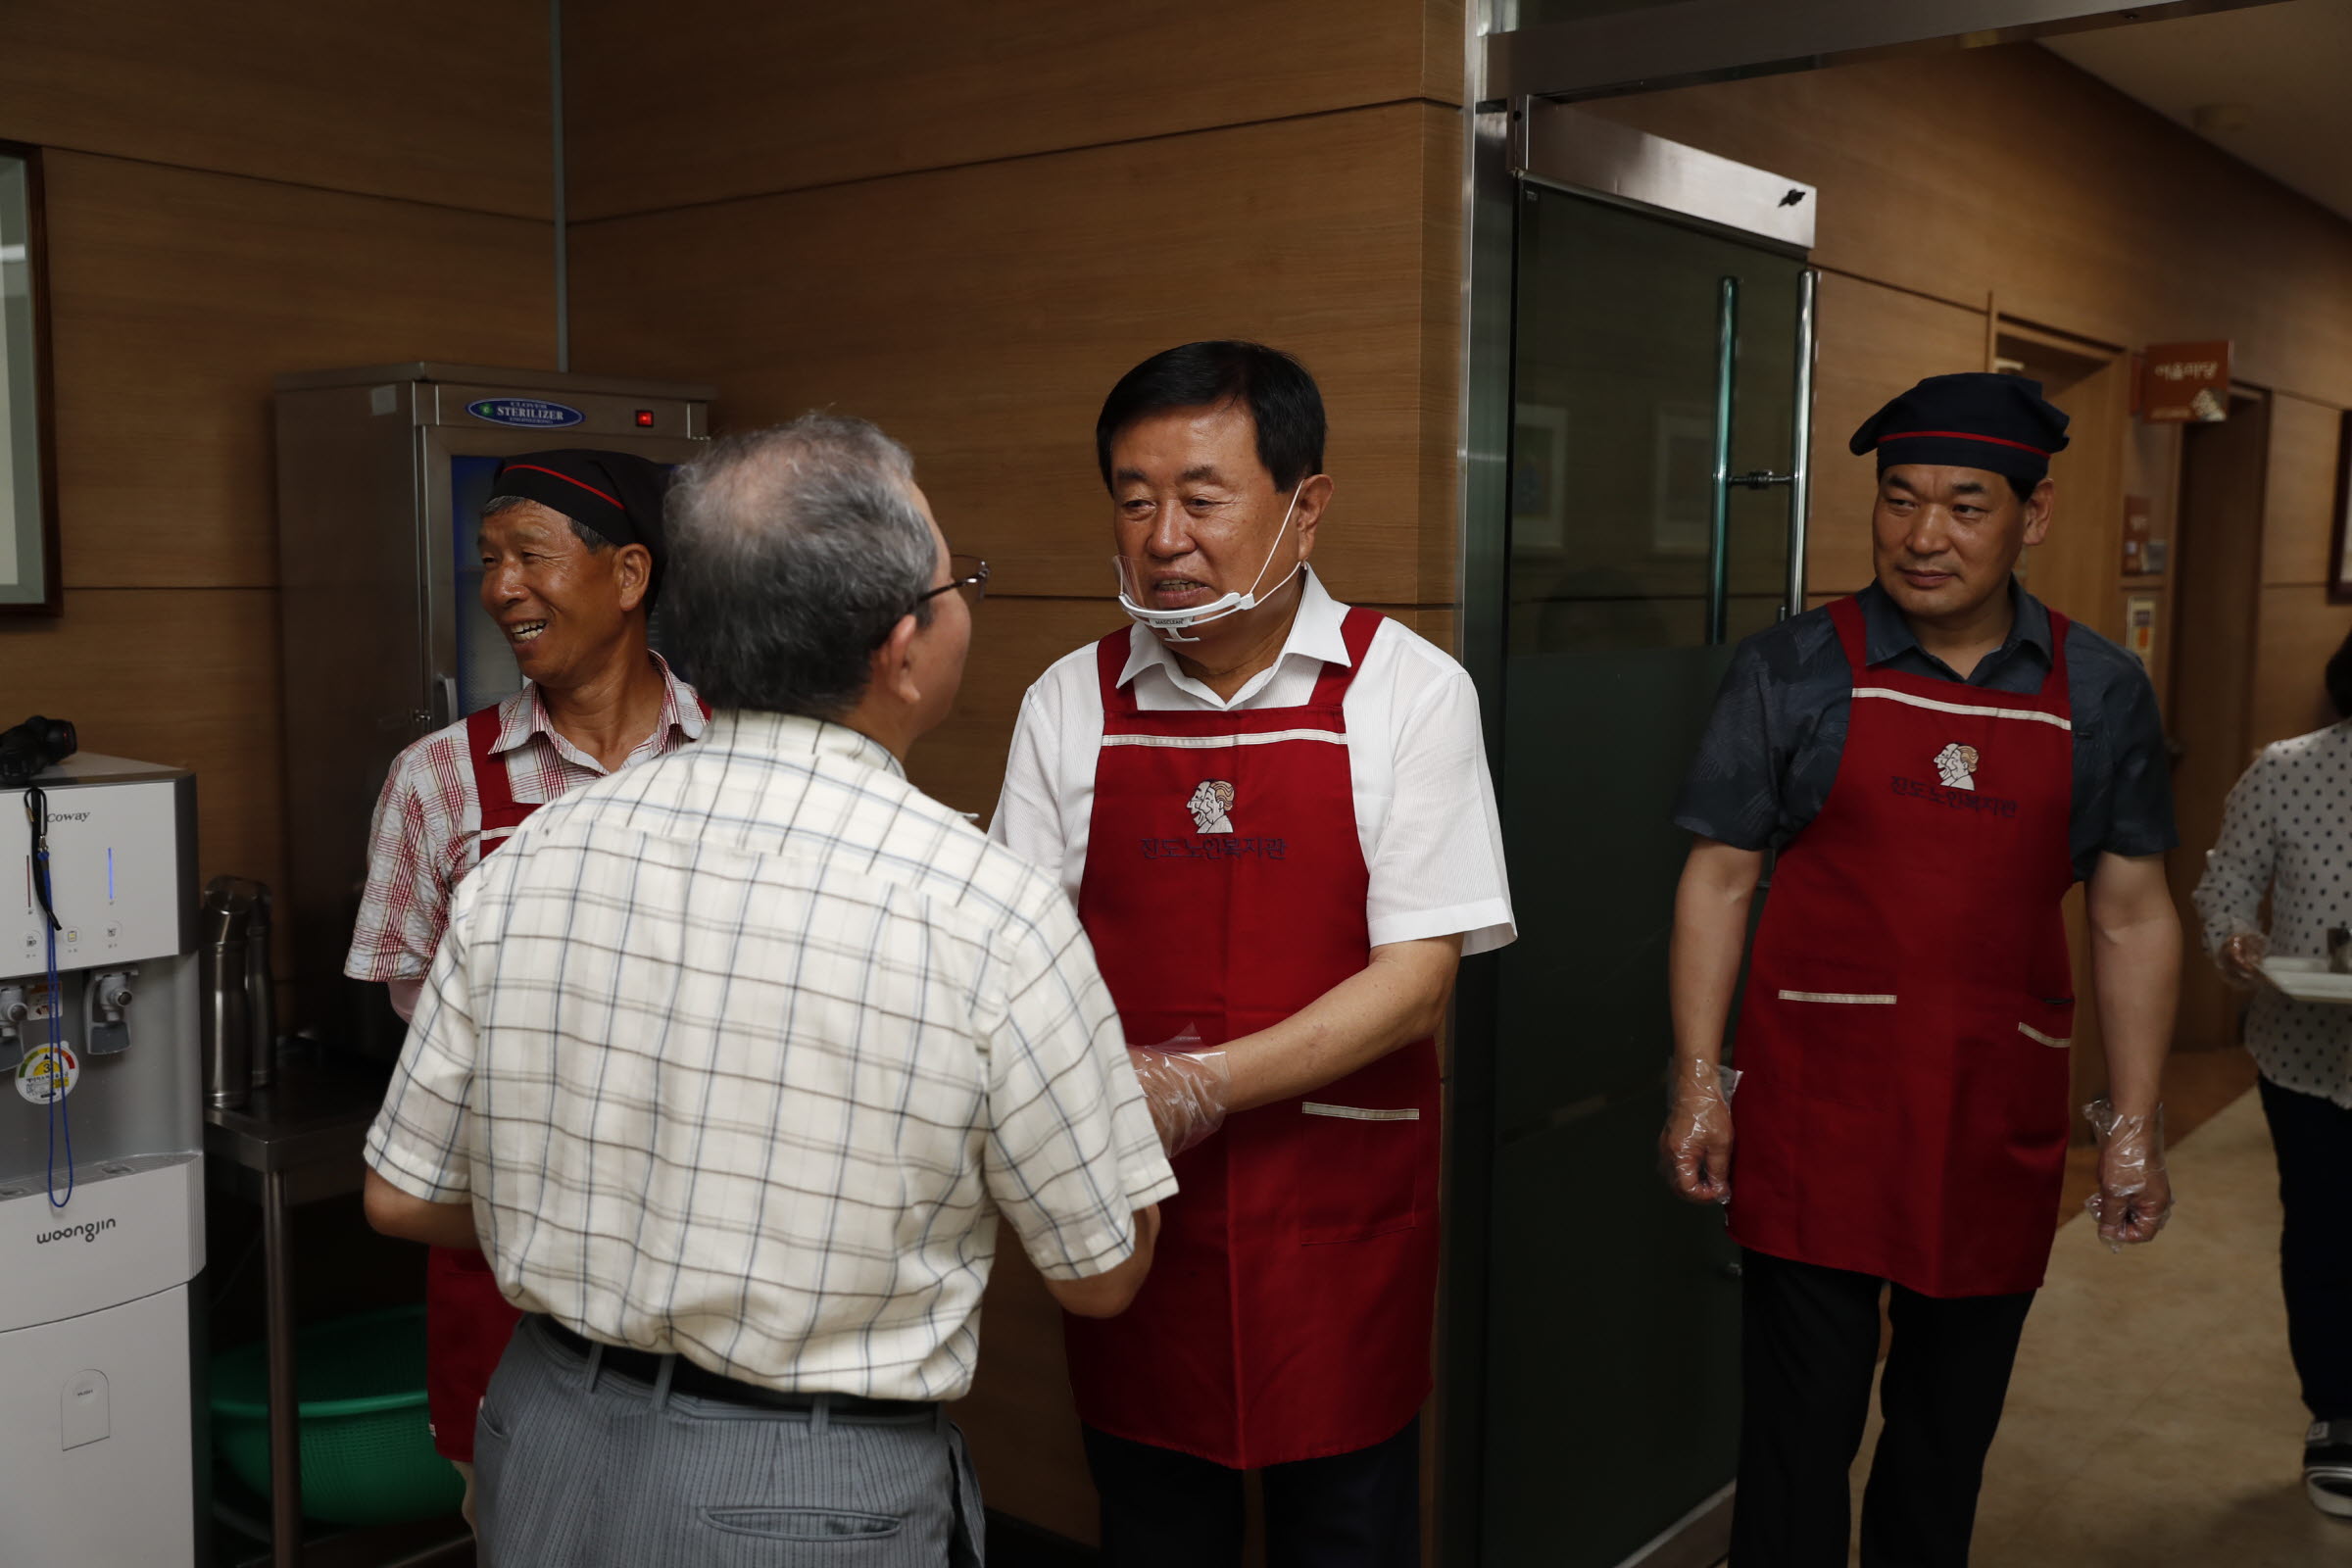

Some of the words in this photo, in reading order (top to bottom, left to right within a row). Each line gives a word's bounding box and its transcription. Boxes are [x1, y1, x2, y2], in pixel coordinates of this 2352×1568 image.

[497, 405, 564, 421] STERILIZER
[47, 810, 91, 823] Coway
[1139, 837, 1289, 860] 진도노인복지관
[43, 1062, 52, 1074] 3
[36, 1218, 116, 1243] woongjin
